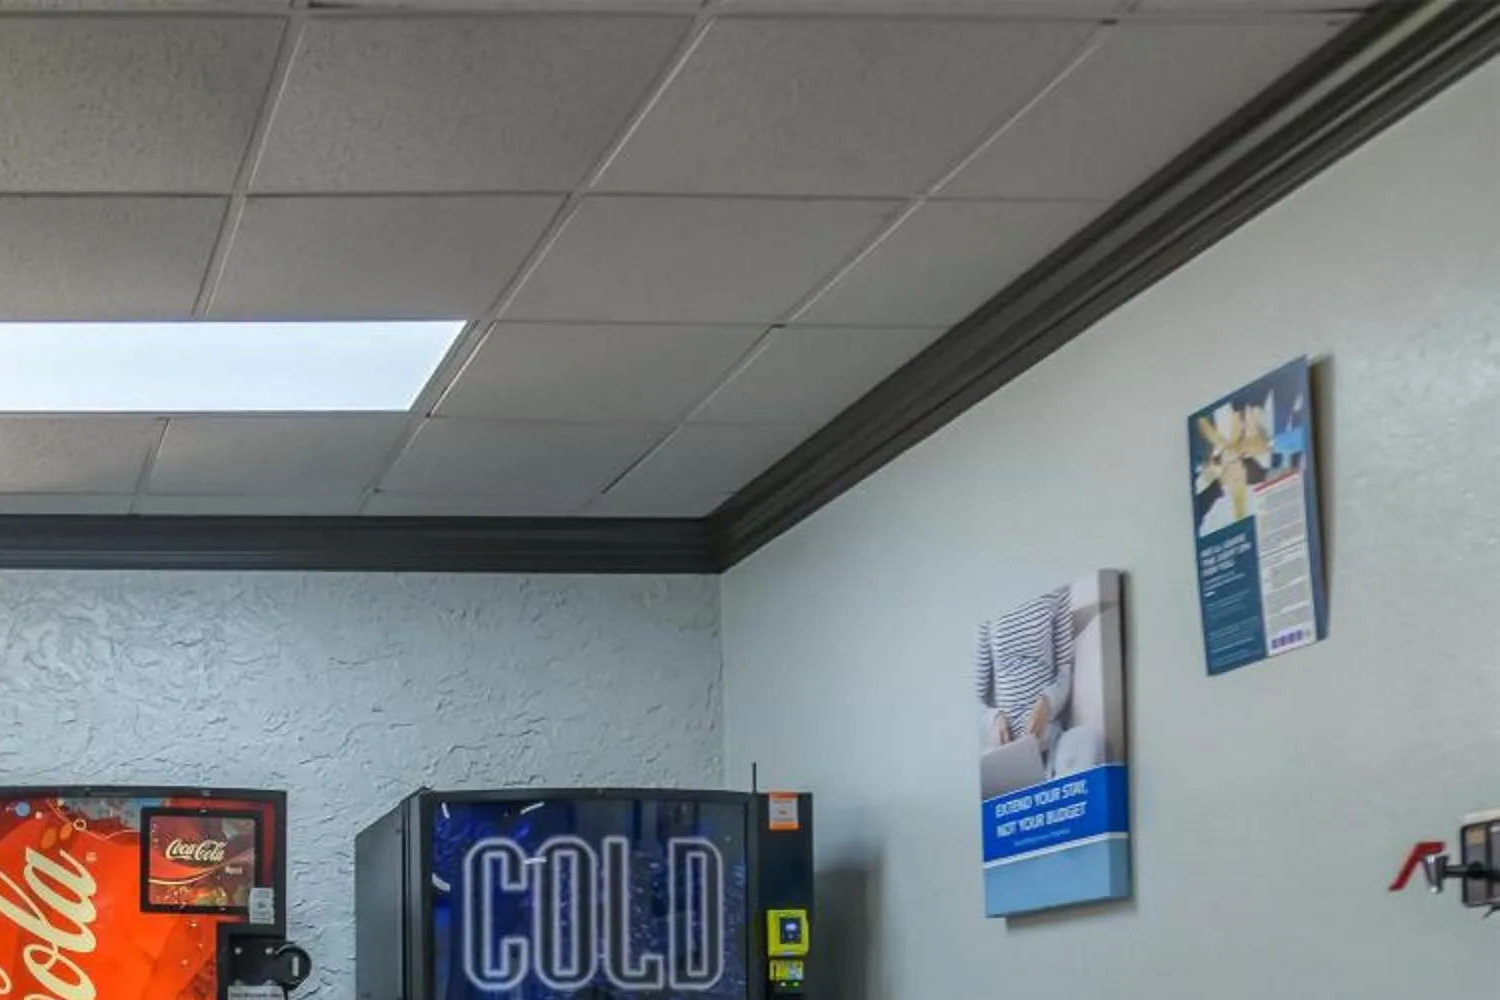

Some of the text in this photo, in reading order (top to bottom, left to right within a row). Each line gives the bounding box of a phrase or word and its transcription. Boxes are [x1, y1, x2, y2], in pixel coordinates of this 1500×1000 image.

[1034, 787, 1061, 806] YOUR
[996, 821, 1017, 837] NOT
[1018, 813, 1045, 832] YOUR
[1045, 802, 1087, 825] BUDGET
[464, 835, 724, 991] COLD
